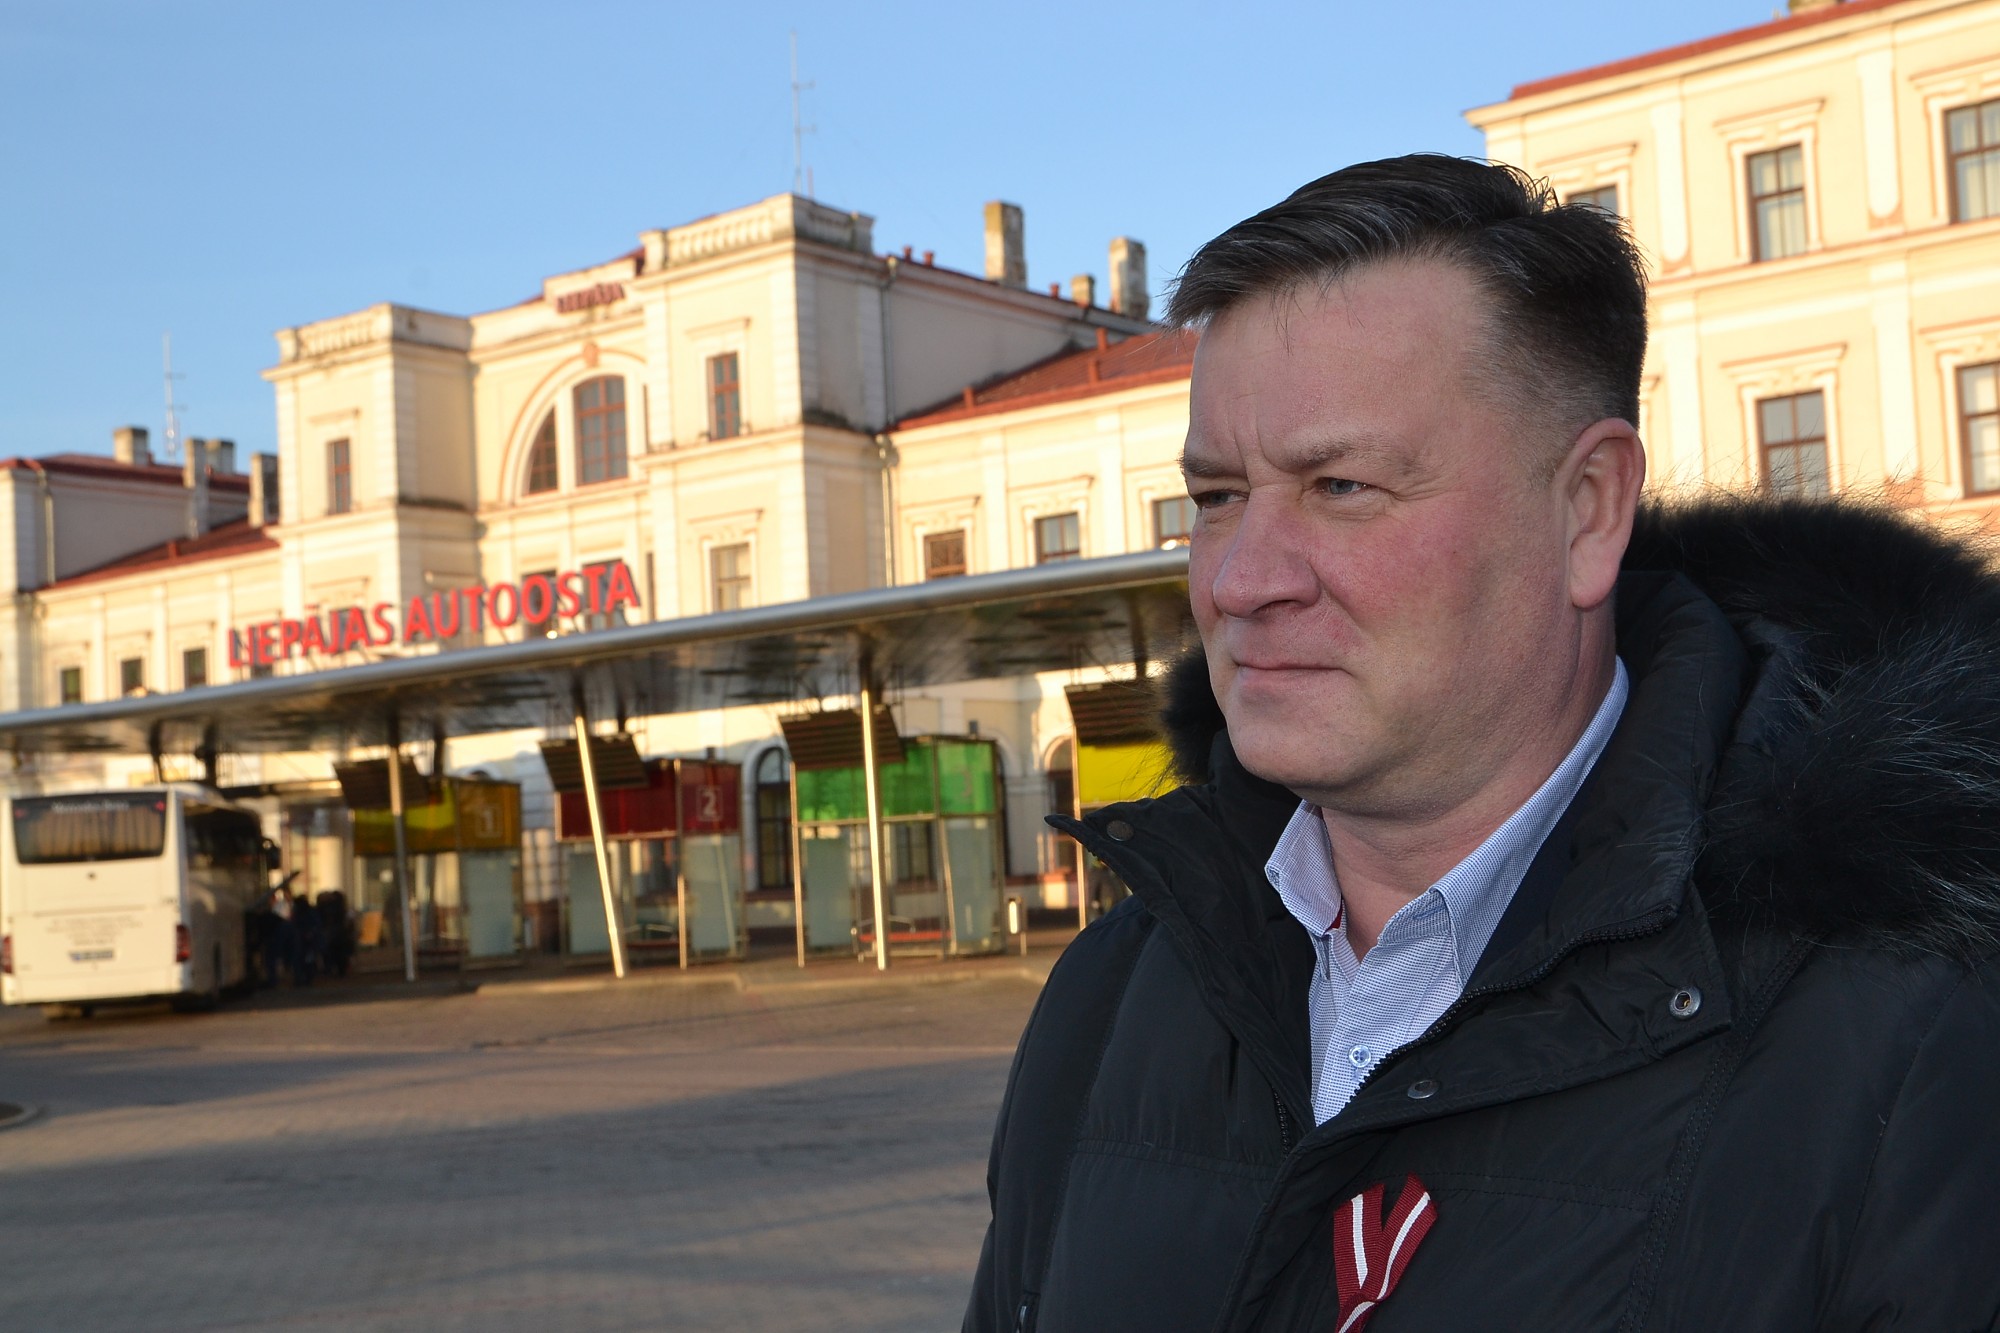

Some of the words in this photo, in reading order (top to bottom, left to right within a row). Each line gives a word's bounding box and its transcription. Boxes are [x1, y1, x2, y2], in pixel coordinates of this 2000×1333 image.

[228, 603, 394, 668] LIEPĀJAS
[404, 561, 639, 642] AUTOOSTA
[701, 789, 717, 816] 2
